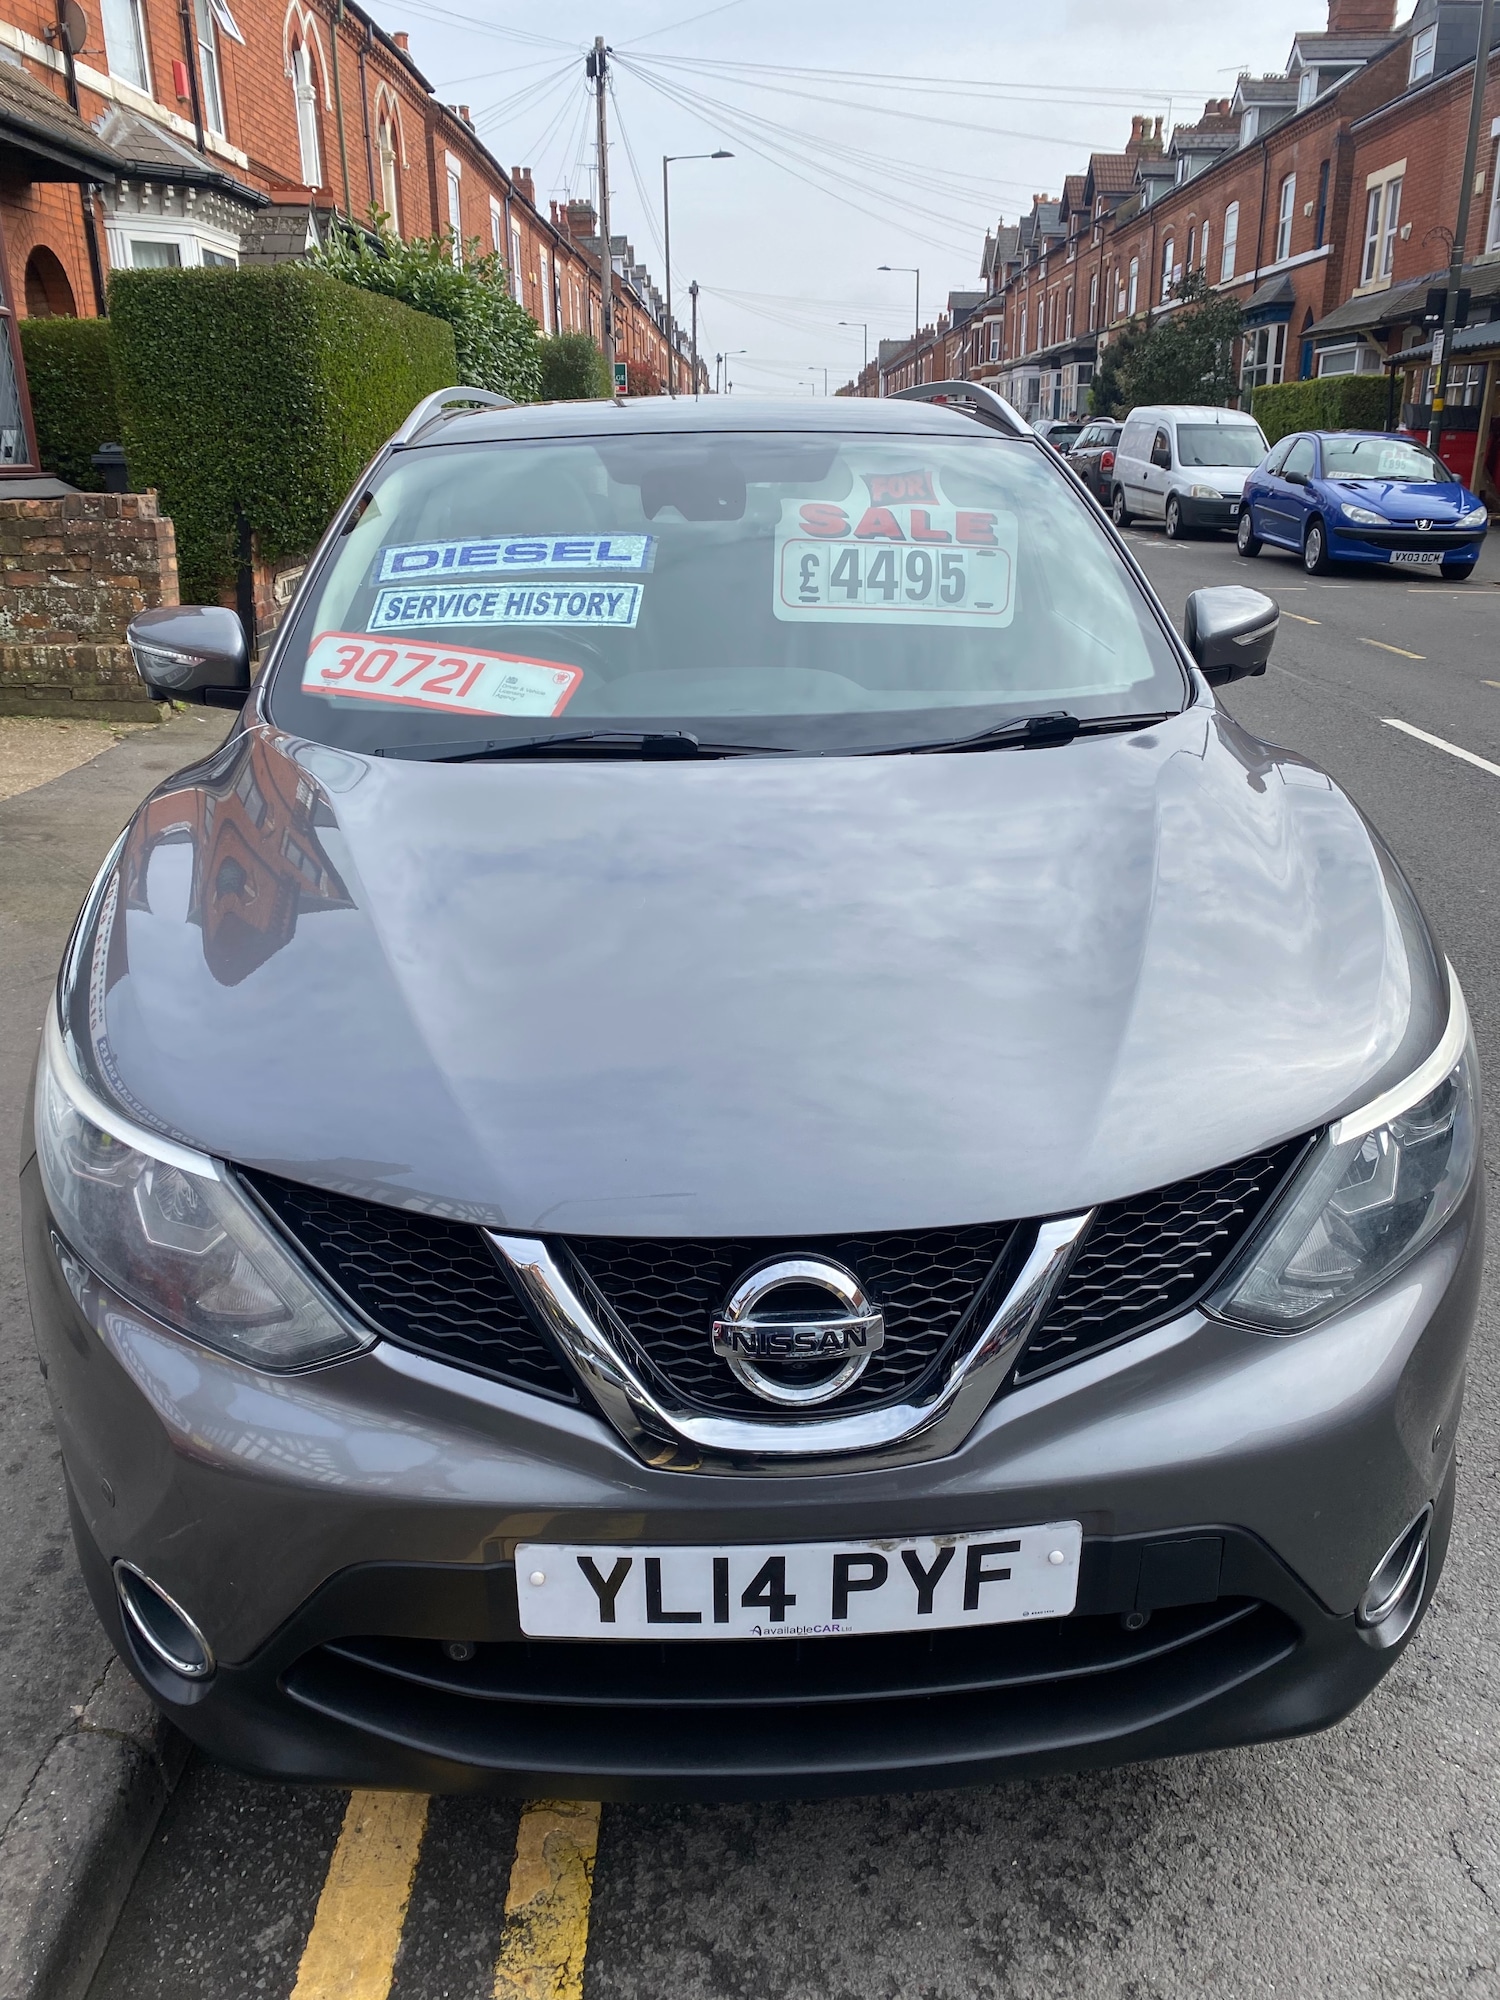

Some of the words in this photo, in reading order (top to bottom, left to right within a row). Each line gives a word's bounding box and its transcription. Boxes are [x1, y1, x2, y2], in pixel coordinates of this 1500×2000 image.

[870, 475, 926, 501] FOR
[799, 503, 998, 546] SALE
[391, 541, 632, 573] DIESEL
[1395, 552, 1420, 562] VX03
[384, 593, 499, 621] SERVICE
[504, 591, 624, 617] HISTORY
[320, 645, 486, 697] 30721
[732, 1327, 867, 1355] NISSAN
[577, 1556, 797, 1624] YL14
[831, 1540, 1022, 1620] PYF
